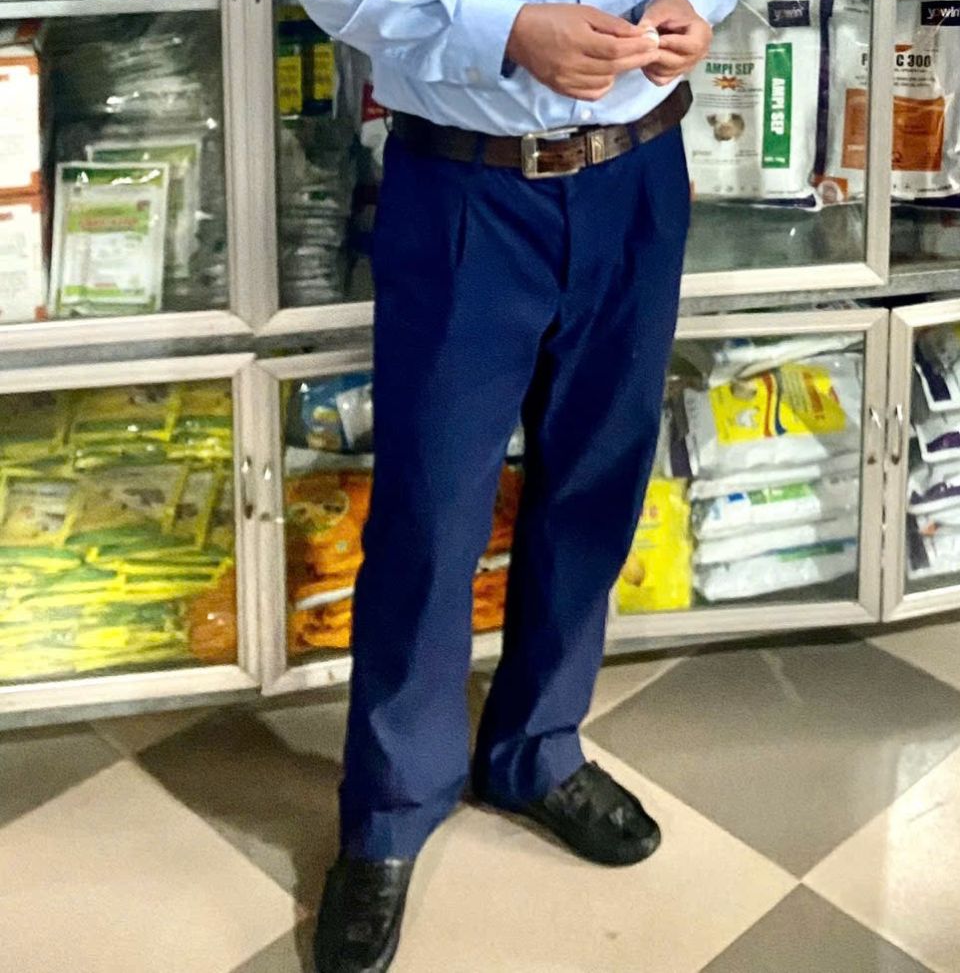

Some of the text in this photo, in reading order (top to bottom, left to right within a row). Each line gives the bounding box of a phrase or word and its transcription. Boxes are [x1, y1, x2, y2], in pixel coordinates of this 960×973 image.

[907, 55, 932, 68] 300
[705, 62, 755, 75] AMPI SEP
[771, 78, 785, 135] AMPI SEP
